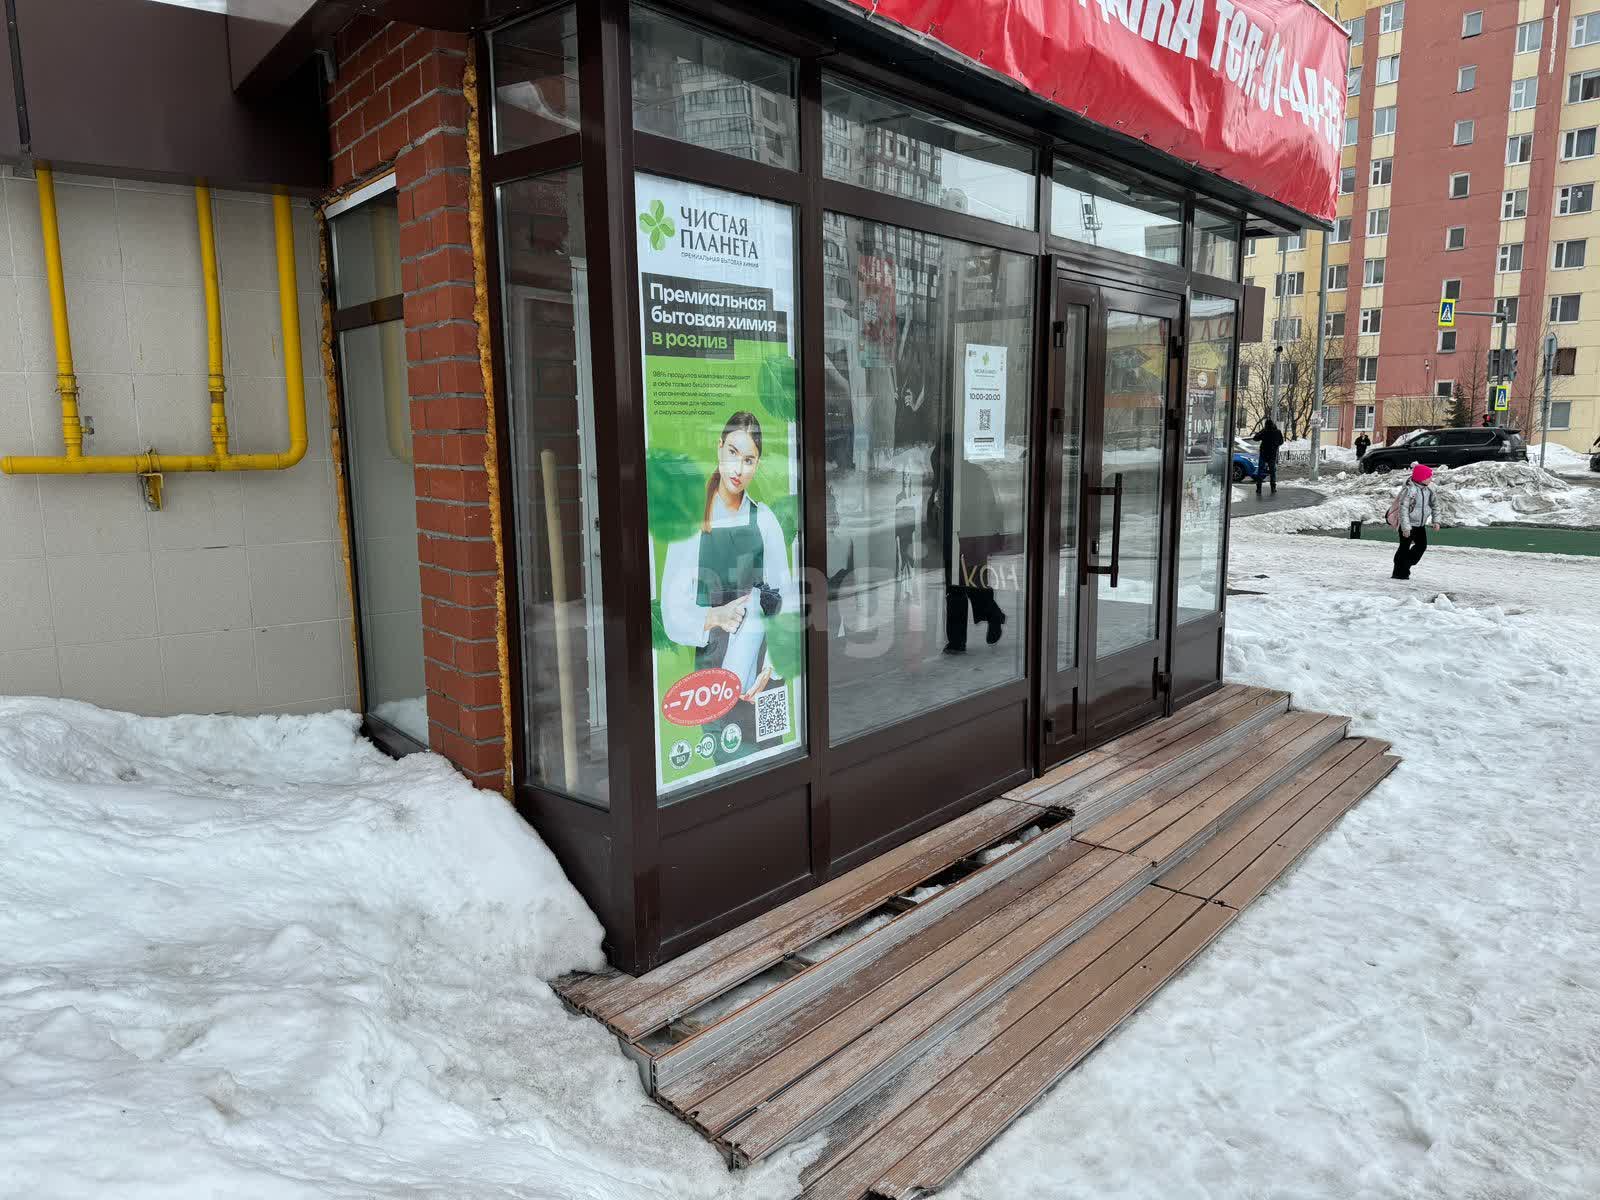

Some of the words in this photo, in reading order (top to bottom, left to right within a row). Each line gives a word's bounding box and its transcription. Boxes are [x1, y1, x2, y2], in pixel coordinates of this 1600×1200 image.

[680, 206, 748, 237] ЧИСТАЯ
[680, 229, 759, 259] ПЛАНЕТА
[650, 283, 767, 311] Премиальная
[651, 305, 725, 328] бытовая
[727, 316, 777, 333] химия
[652, 331, 663, 345] в
[665, 331, 728, 349] розлив
[669, 681, 733, 711] -70%
